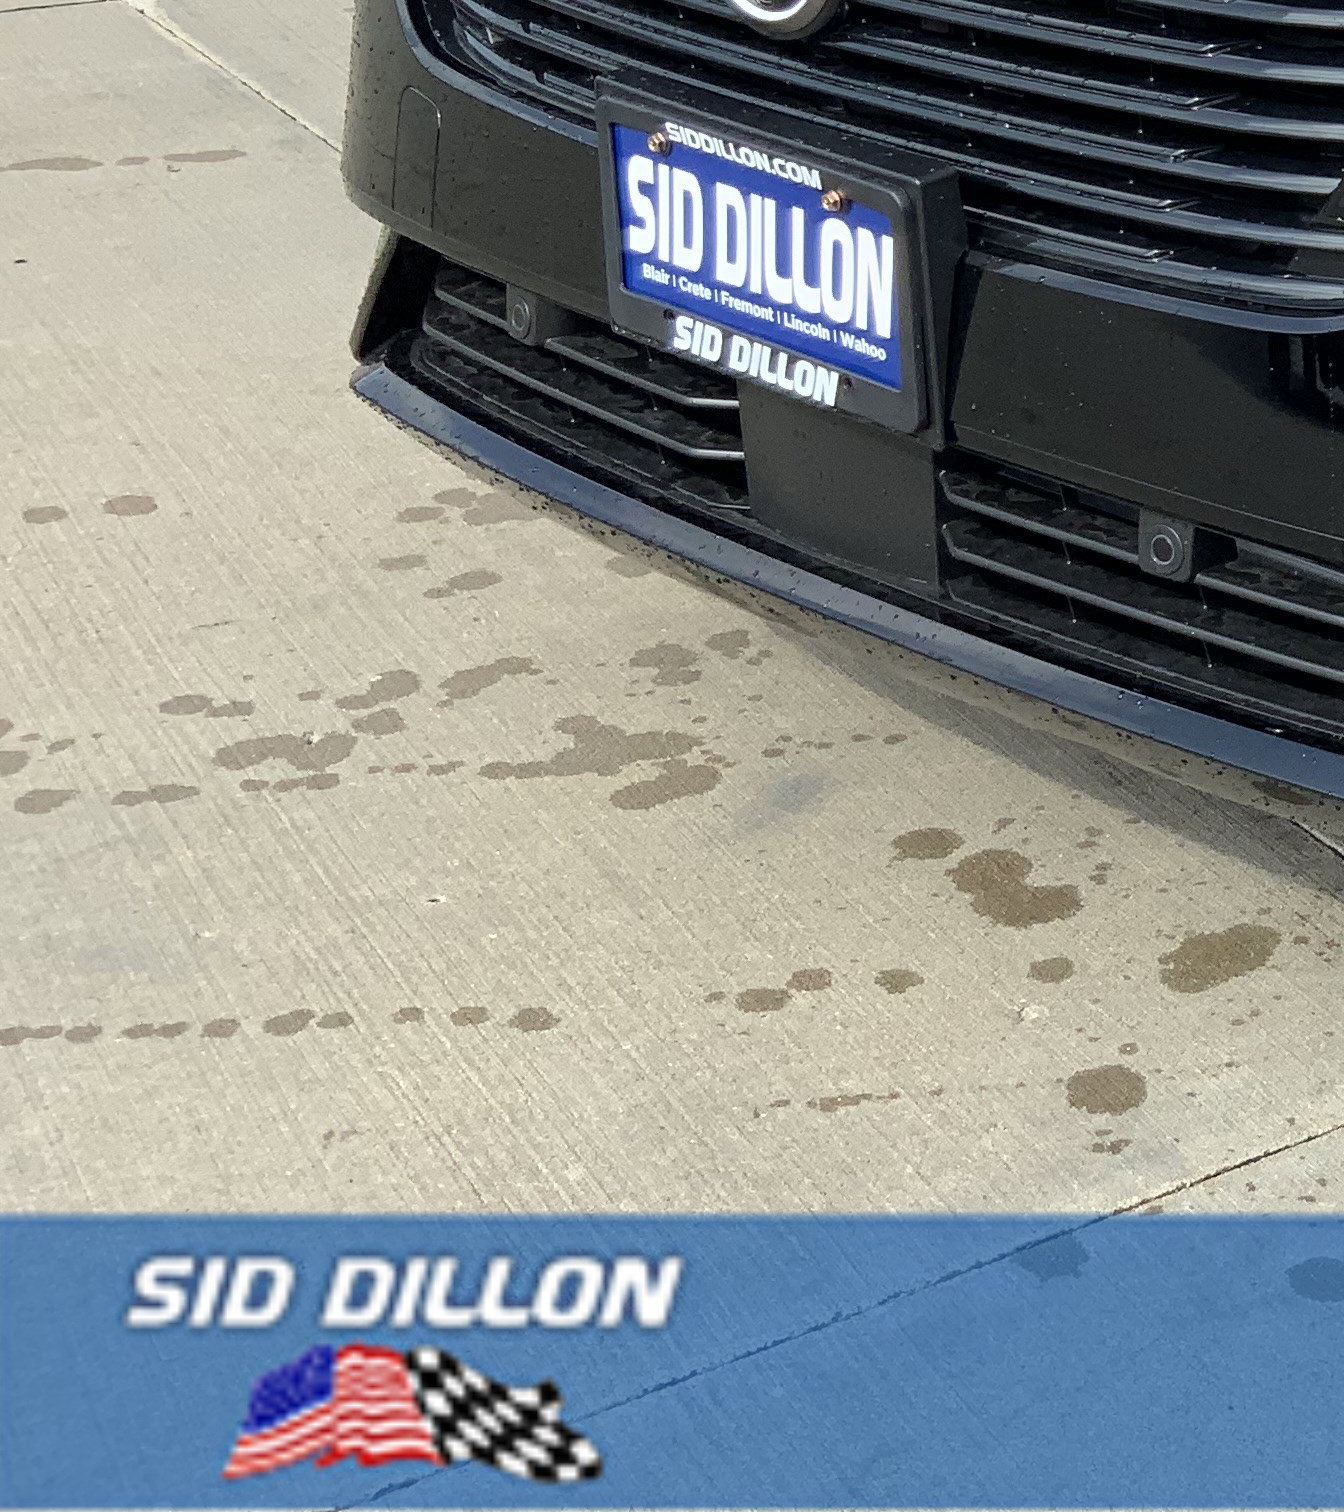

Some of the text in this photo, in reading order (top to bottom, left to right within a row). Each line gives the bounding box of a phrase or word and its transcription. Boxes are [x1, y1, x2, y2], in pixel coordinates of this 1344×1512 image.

[664, 121, 822, 190] SIDDILLON.COM
[627, 154, 894, 339] SID DILLON
[642, 262, 887, 361] Blair Crete Fremont Lincoln Wahoo
[673, 315, 840, 407] SID DILLON
